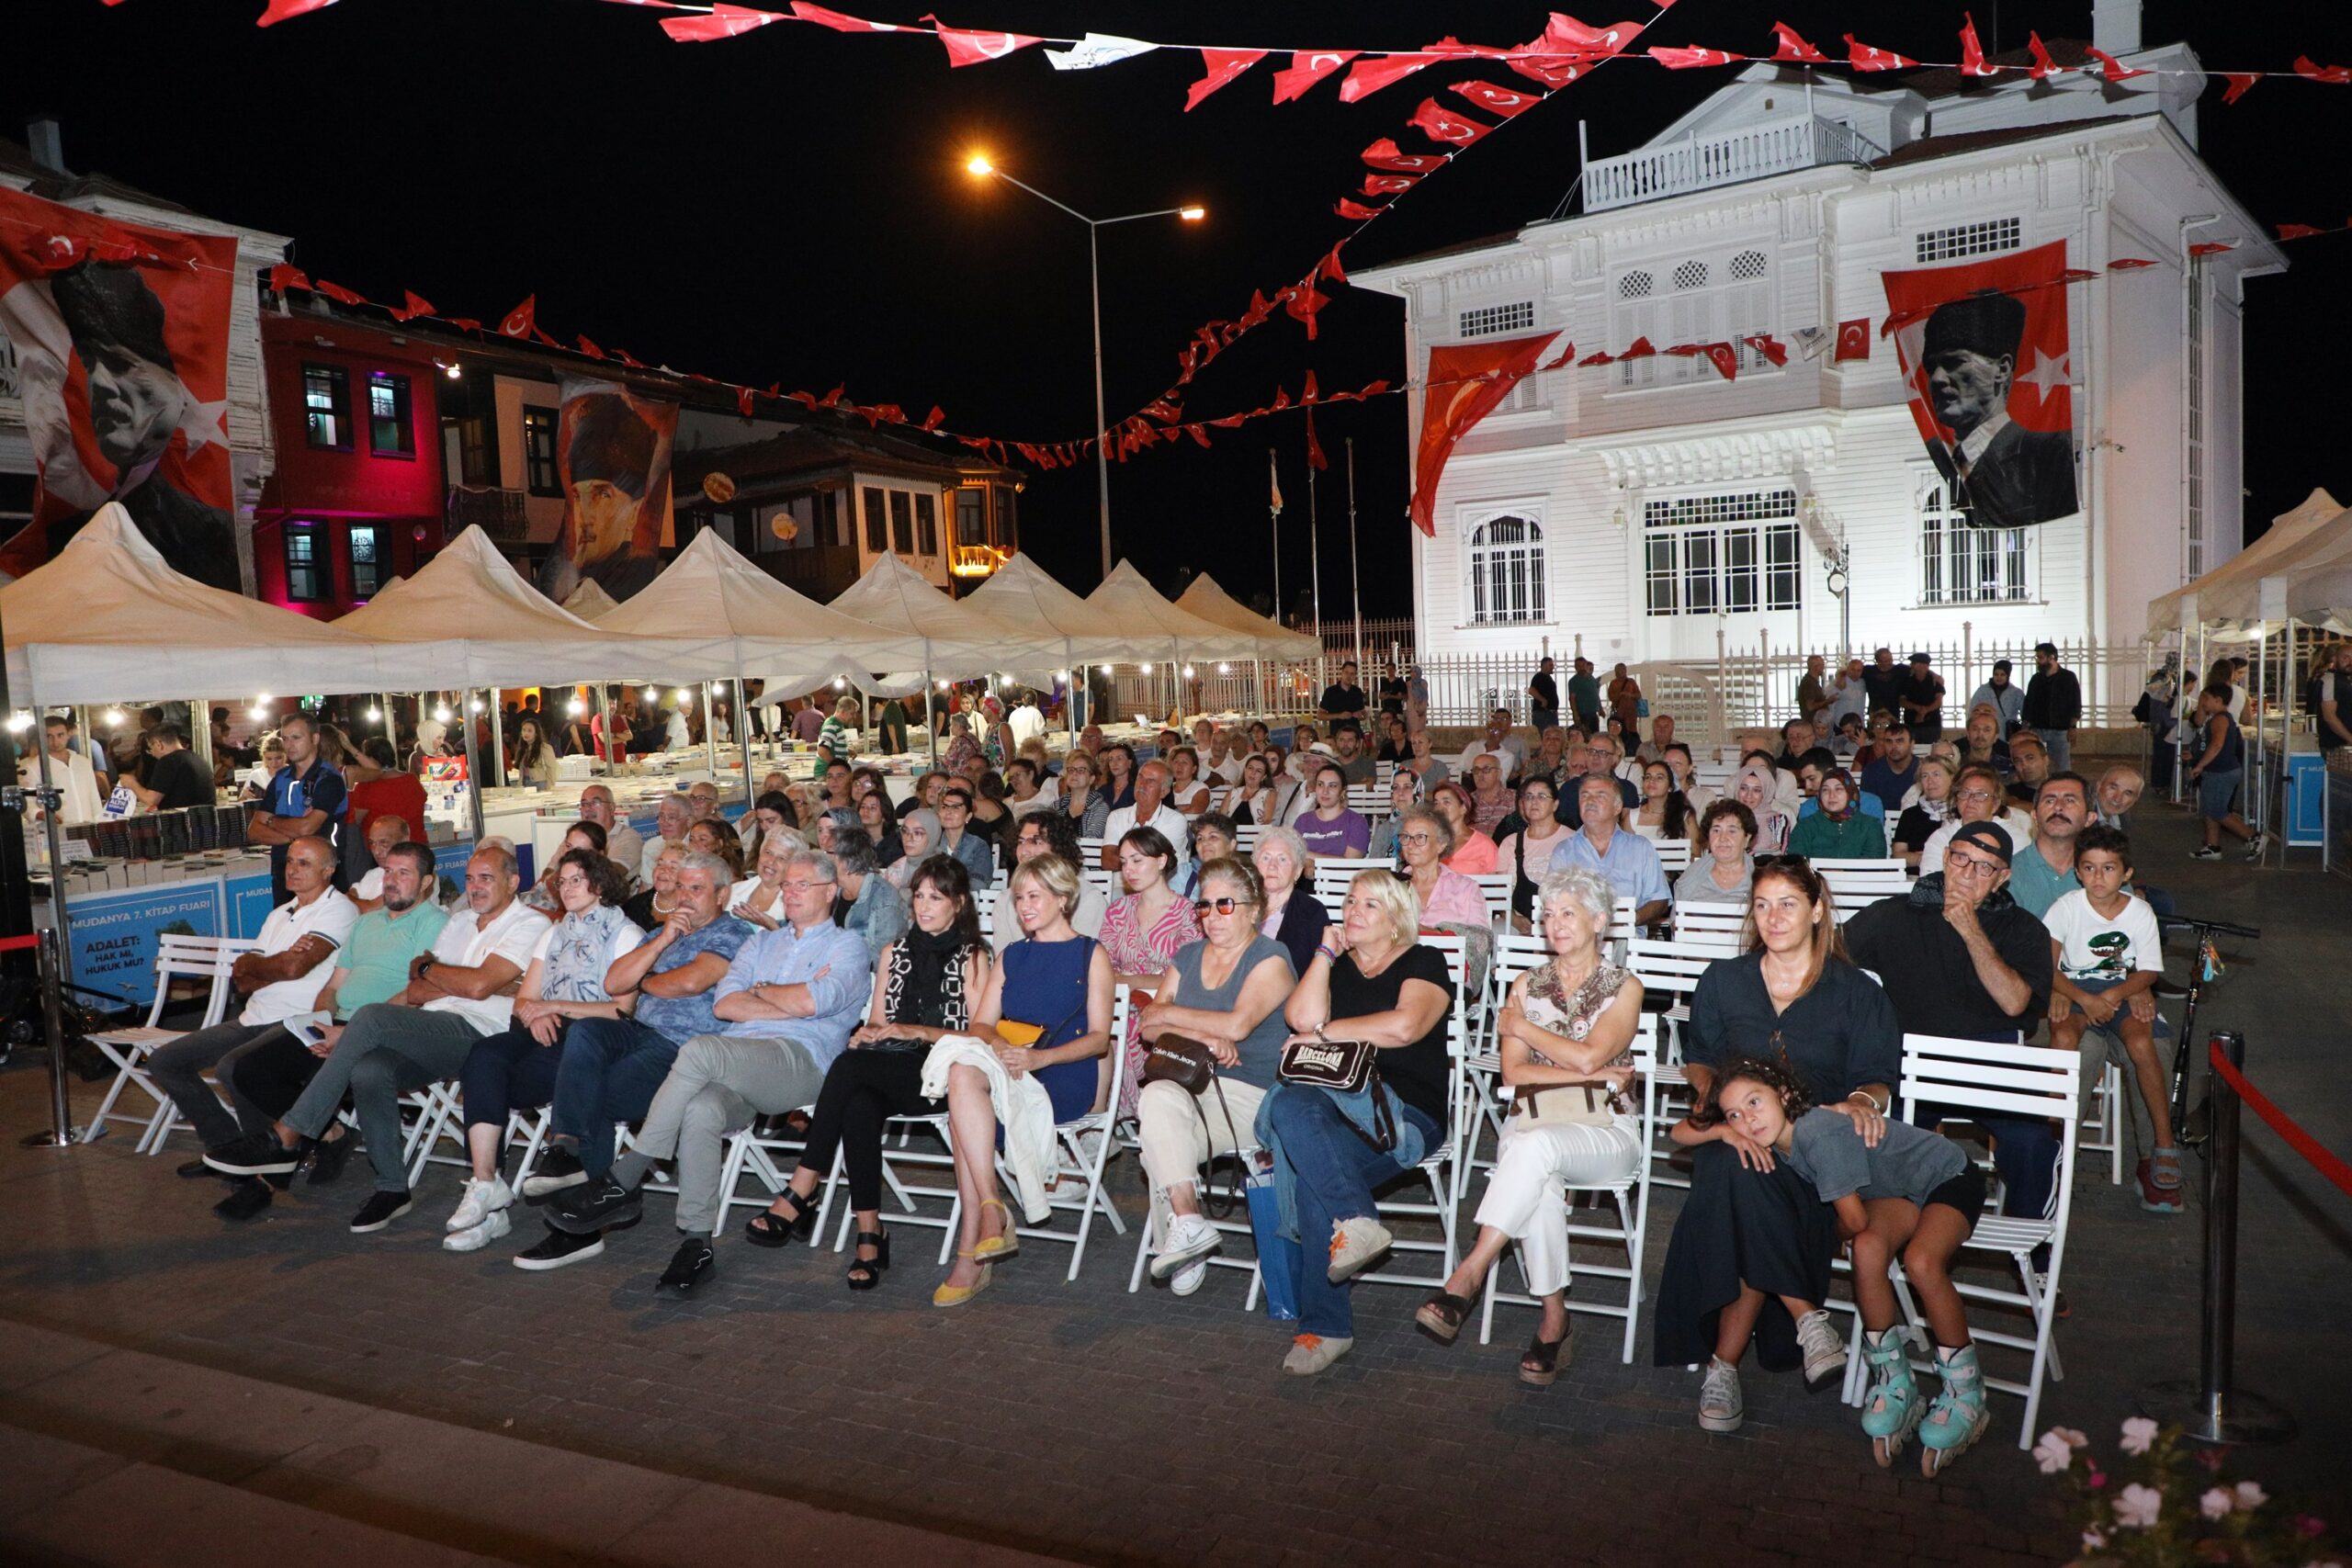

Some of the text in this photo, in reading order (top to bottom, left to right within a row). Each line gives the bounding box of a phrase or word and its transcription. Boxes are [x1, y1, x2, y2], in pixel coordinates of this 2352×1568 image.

[72, 899, 210, 931] MUDANYA 7. KİTAP FUARI
[85, 935, 141, 953] ADALET:
[85, 957, 144, 976] HUKUK MU?
[95, 953, 118, 963] HAK
[1295, 1045, 1344, 1067] BARCELONA
